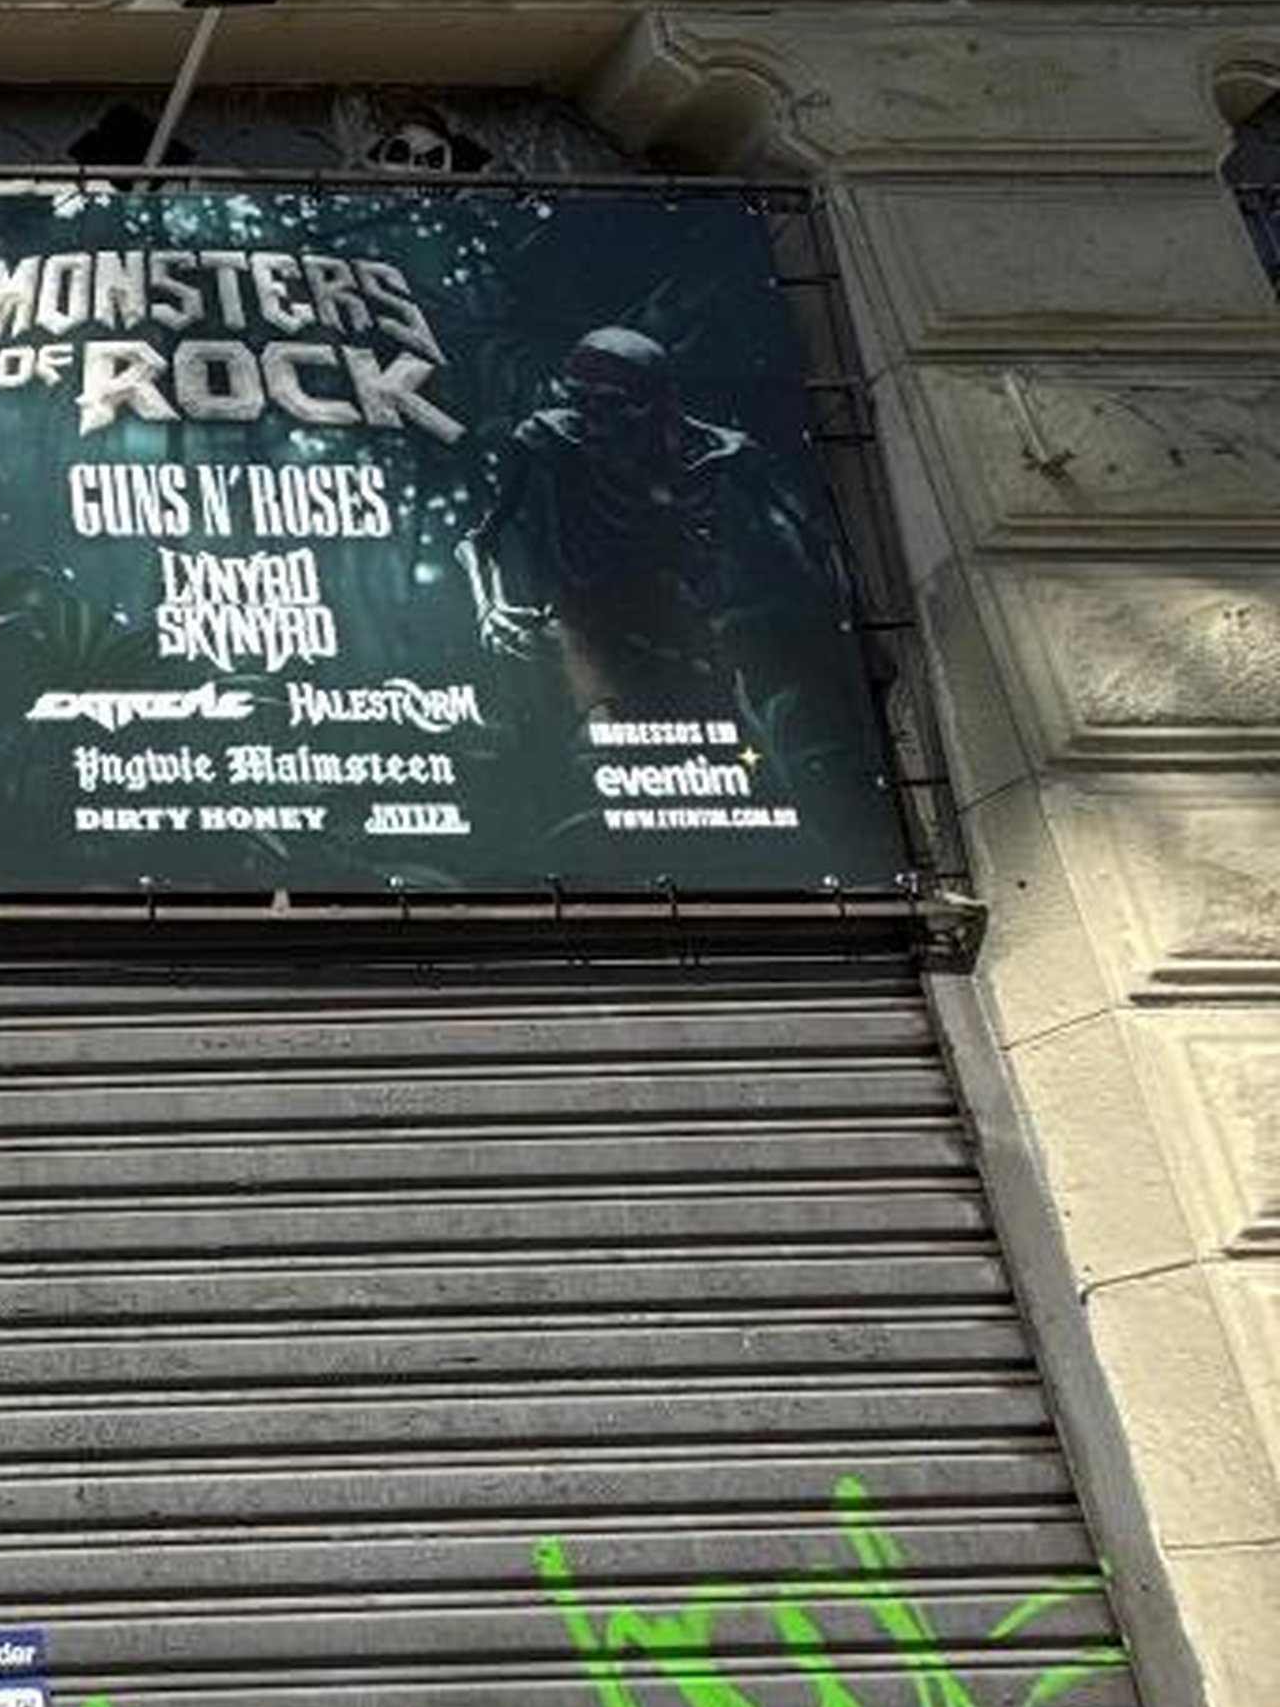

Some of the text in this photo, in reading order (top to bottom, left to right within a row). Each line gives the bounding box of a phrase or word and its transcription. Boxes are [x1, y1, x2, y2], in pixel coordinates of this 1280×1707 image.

[75, 339, 466, 443] ROCK
[69, 463, 192, 538] GUNS
[247, 463, 391, 538] ROSES
[157, 546, 321, 606] LYNYRD
[156, 603, 338, 673] SKYNYRD
[73, 745, 217, 792] Yngwie
[594, 754, 750, 796] eventim
[74, 805, 327, 831] DIRTY HONEY
